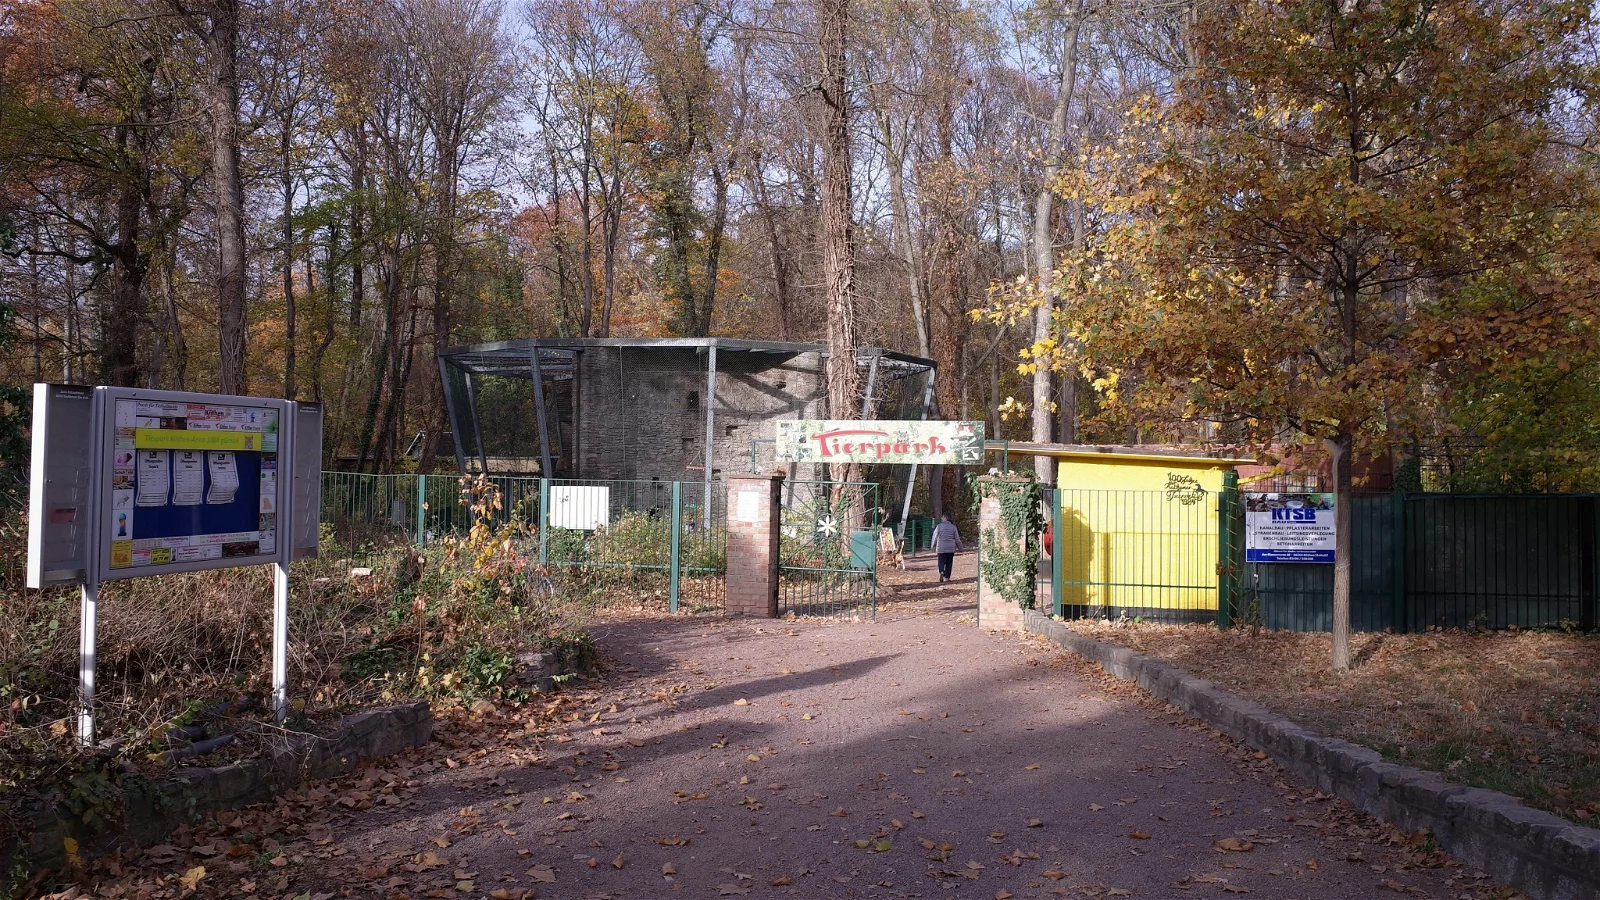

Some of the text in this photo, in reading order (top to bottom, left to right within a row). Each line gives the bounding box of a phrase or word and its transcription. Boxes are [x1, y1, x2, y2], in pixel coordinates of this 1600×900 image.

[145, 435, 169, 443] Tierpark
[810, 428, 946, 459] Tierpark
[1167, 472, 1182, 482] 100
[1272, 508, 1316, 520] KTSB
